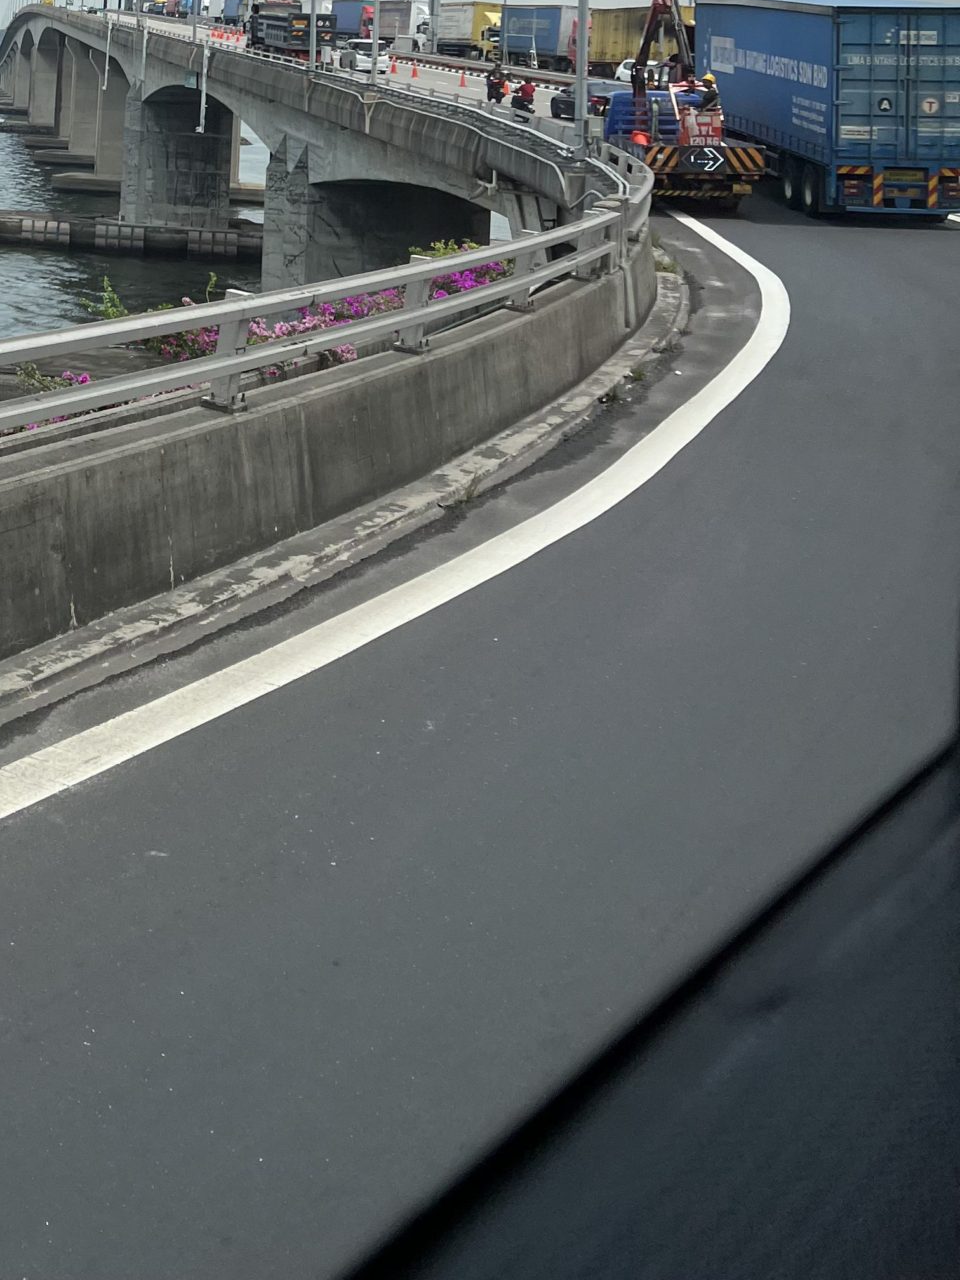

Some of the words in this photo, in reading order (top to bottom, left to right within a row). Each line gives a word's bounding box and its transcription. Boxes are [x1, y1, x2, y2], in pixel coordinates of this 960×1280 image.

[767, 54, 798, 81] LOGISTICS
[799, 61, 813, 85] SDN
[814, 64, 828, 89] BHD
[880, 100, 890, 110] A
[926, 101, 936, 112] T
[690, 137, 705, 146] 120
[706, 137, 719, 146] KG
